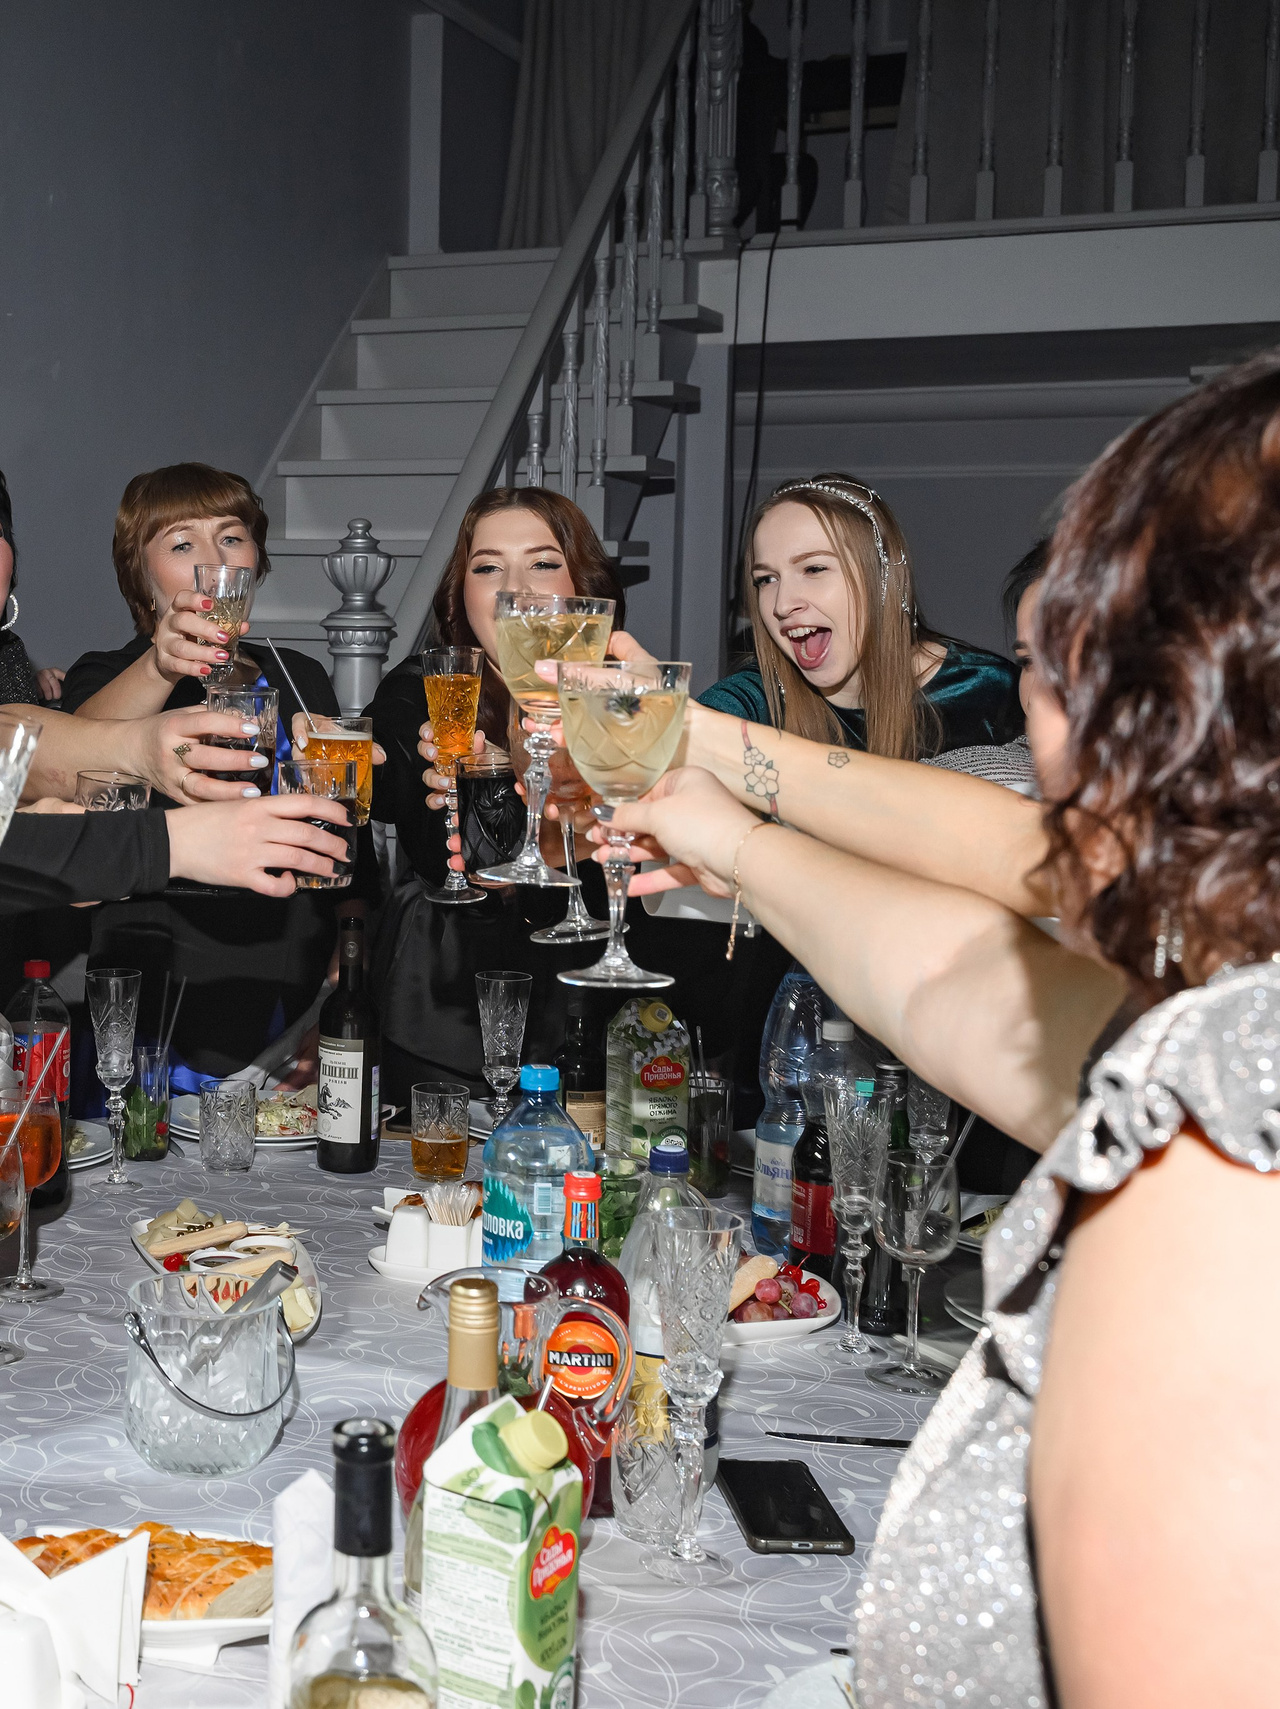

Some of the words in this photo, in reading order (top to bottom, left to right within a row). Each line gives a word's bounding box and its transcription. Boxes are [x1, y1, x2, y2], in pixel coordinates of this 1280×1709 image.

[651, 1065, 673, 1074] Сады
[644, 1071, 682, 1082] Придонья
[648, 1095, 678, 1104] ЯБЛОКО
[649, 1102, 678, 1110] ПРЯМОГО
[649, 1109, 677, 1117] ОТЖИМА
[548, 1351, 613, 1367] MARTINI
